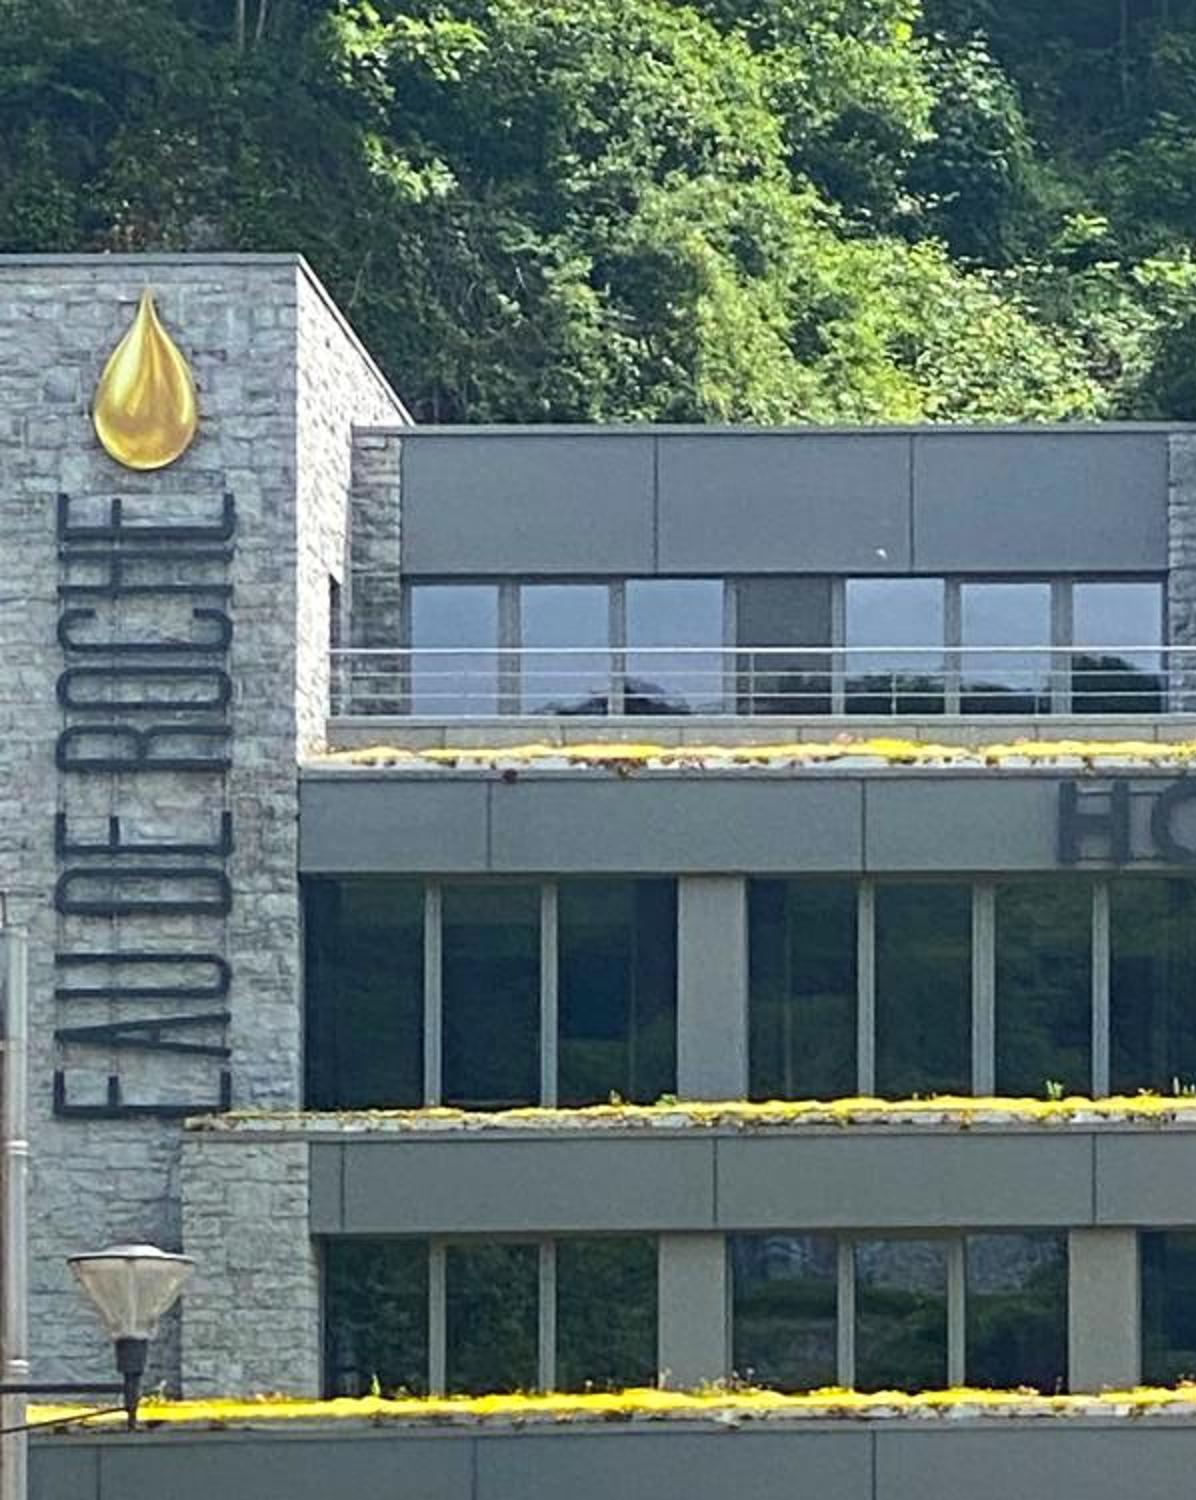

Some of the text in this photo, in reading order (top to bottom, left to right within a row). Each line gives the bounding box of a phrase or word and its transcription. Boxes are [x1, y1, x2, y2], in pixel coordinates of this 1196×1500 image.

[56, 492, 233, 1117] EAU DE ROCHE
